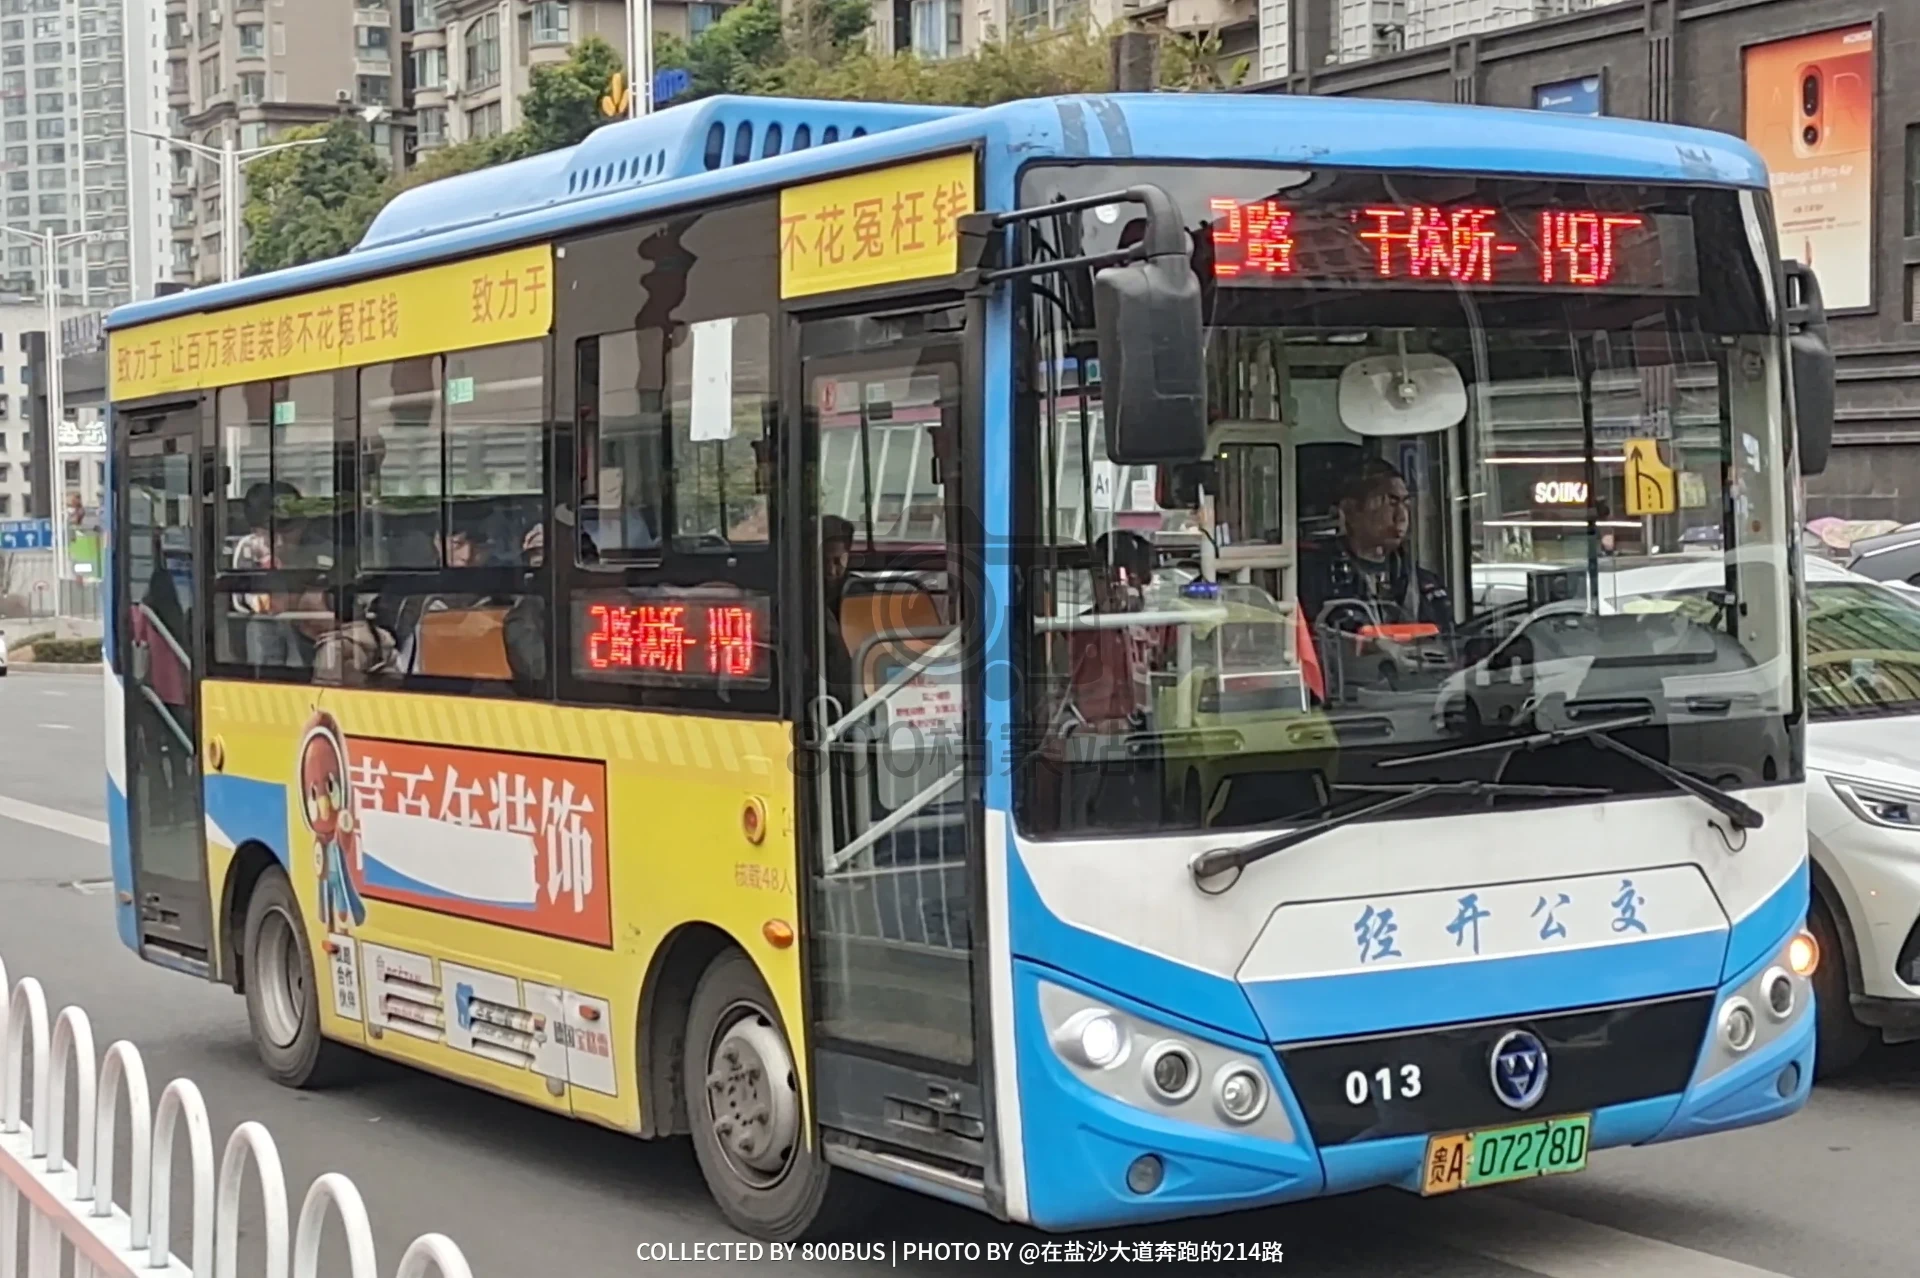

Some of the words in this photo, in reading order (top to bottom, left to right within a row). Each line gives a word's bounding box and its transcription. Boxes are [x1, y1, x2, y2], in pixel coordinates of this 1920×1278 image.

[781, 181, 968, 271] 不花冤枉钱
[472, 265, 546, 323] 致力于
[117, 340, 162, 383] 致力于
[1354, 879, 1648, 963] 经开公交
[1345, 1064, 1422, 1104] 013
[1479, 1124, 1586, 1177] 07278D
